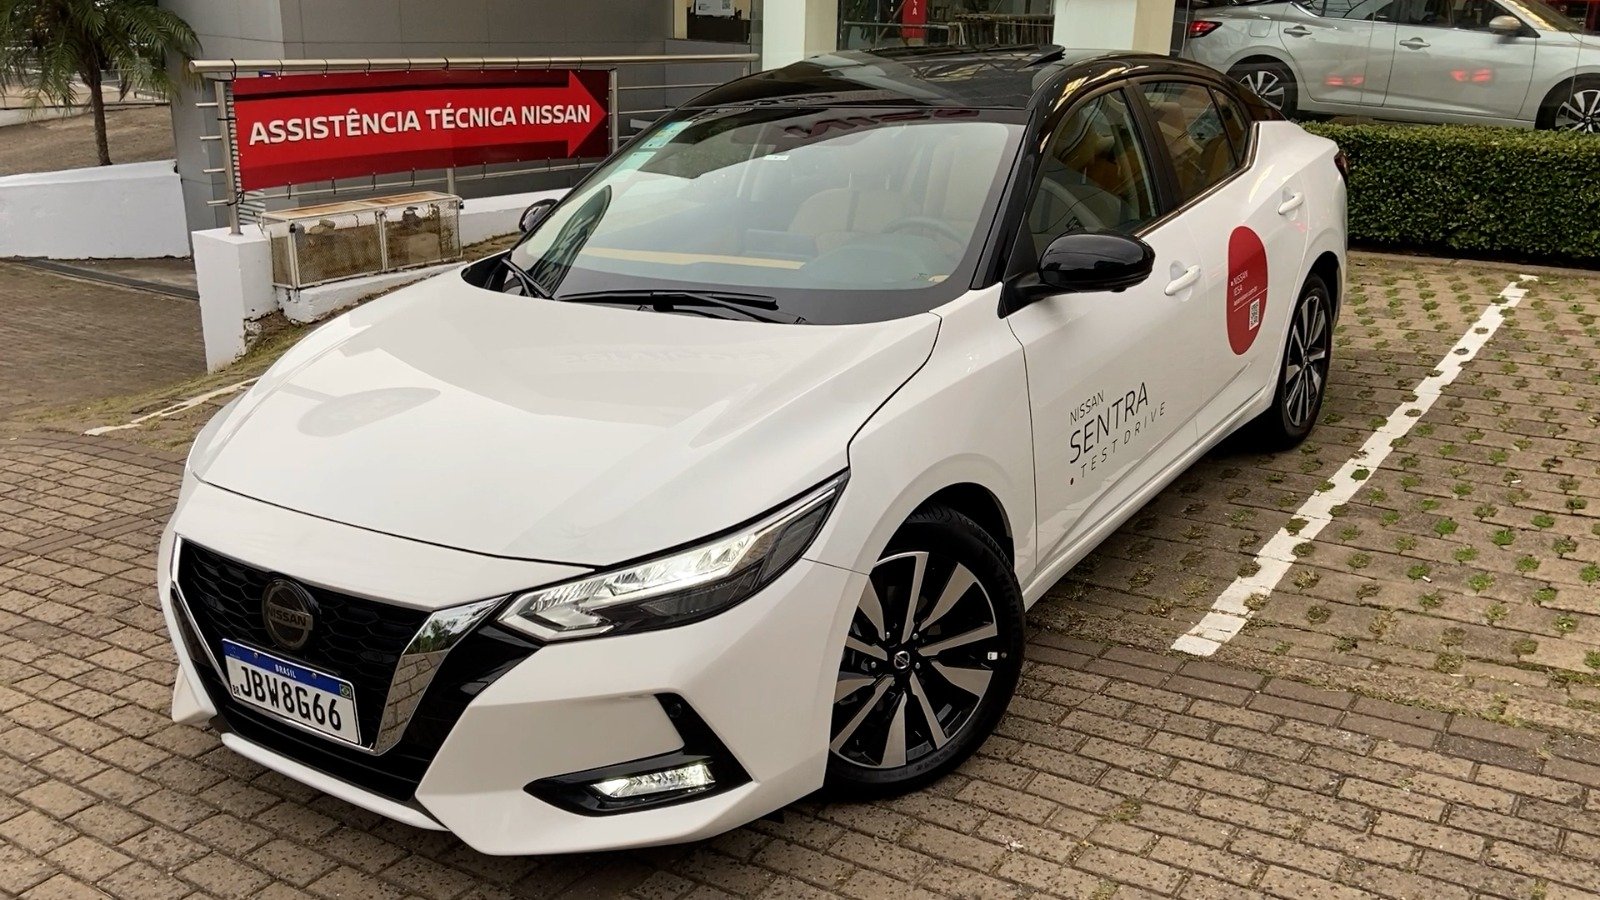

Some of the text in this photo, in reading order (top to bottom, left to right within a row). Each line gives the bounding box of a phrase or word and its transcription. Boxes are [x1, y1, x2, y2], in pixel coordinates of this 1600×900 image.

[249, 103, 591, 146] ASSISTÊNCIA TÉCNICA NISSAN
[1070, 390, 1105, 425] NISSAN
[1070, 382, 1148, 464] SENTRA
[1080, 401, 1166, 478] TEST DRIVE
[268, 607, 307, 627] NISSAN
[275, 664, 296, 678] BRASIL
[240, 666, 342, 731] JBW8G66
